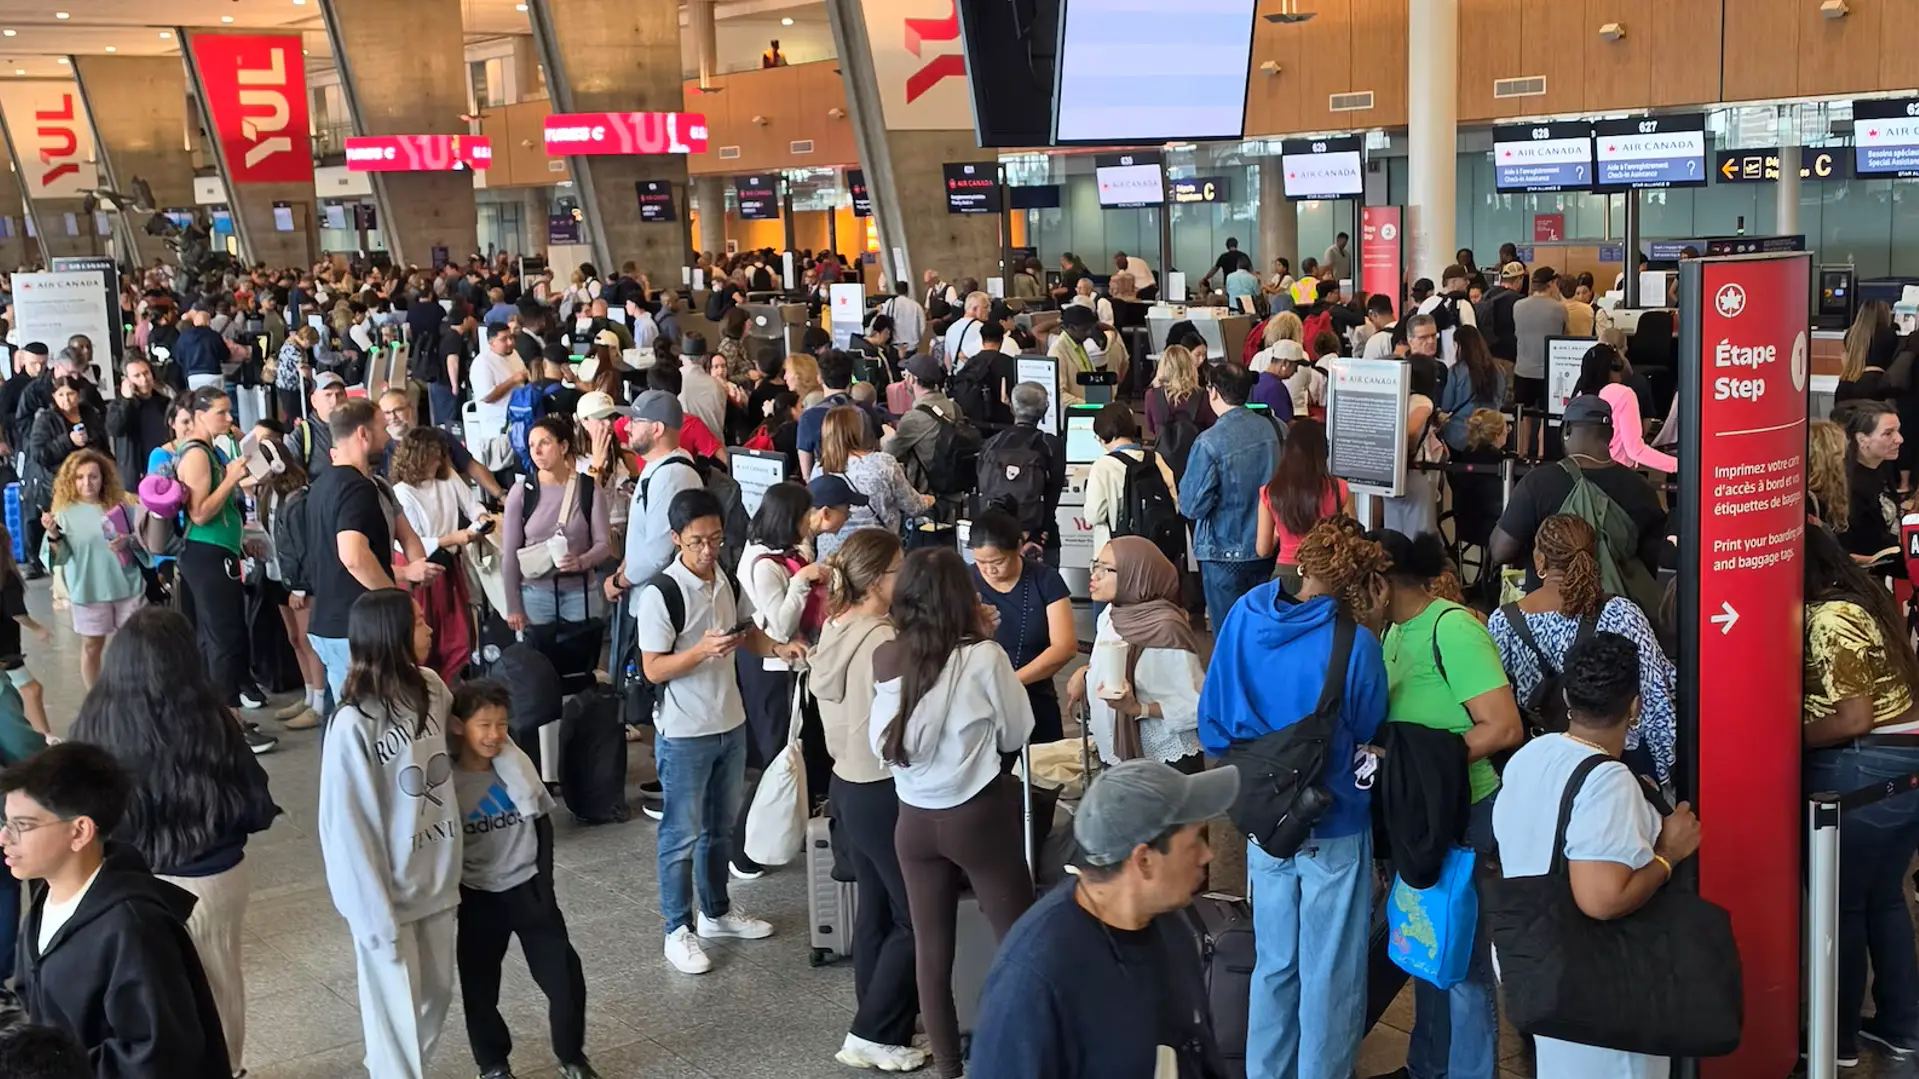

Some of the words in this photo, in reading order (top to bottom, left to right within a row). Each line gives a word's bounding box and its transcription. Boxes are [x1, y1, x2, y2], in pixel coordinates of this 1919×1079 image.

[237, 48, 292, 169] YUL
[1532, 128, 1550, 139] 628
[1639, 121, 1657, 133] 627
[1886, 127, 1909, 136] AIR
[35, 94, 80, 187] YUL
[1622, 143, 1641, 151] AIR
[1644, 140, 1695, 151] CANADA
[1518, 148, 1535, 157] AIR
[1537, 146, 1582, 156] CANADA
[1301, 169, 1316, 179] AIR
[1317, 168, 1357, 178] CANADA
[1125, 180, 1158, 188] CANADA
[1203, 182, 1215, 201] C
[38, 281, 55, 289] AIR
[56, 280, 100, 288] CANADA
[1715, 338, 1777, 370] Étape
[1798, 346, 1804, 376] 1
[1349, 376, 1363, 384] AIR
[1363, 377, 1397, 385] CANADA
[1714, 377, 1766, 402] Step
[1714, 463, 1766, 480] Imprimez
[1767, 459, 1788, 472] votre
[1714, 481, 1756, 498] d'accès
[1758, 478, 1765, 492] à
[1766, 475, 1785, 491] bord
[1785, 475, 1792, 488] et
[1714, 500, 1769, 516] étiquettes
[1770, 495, 1781, 509] de
[1713, 537, 1742, 553] Print
[1744, 536, 1768, 552] your
[1713, 557, 1736, 571] and
[1738, 553, 1780, 569] baggage
[1780, 548, 1795, 562] tags
